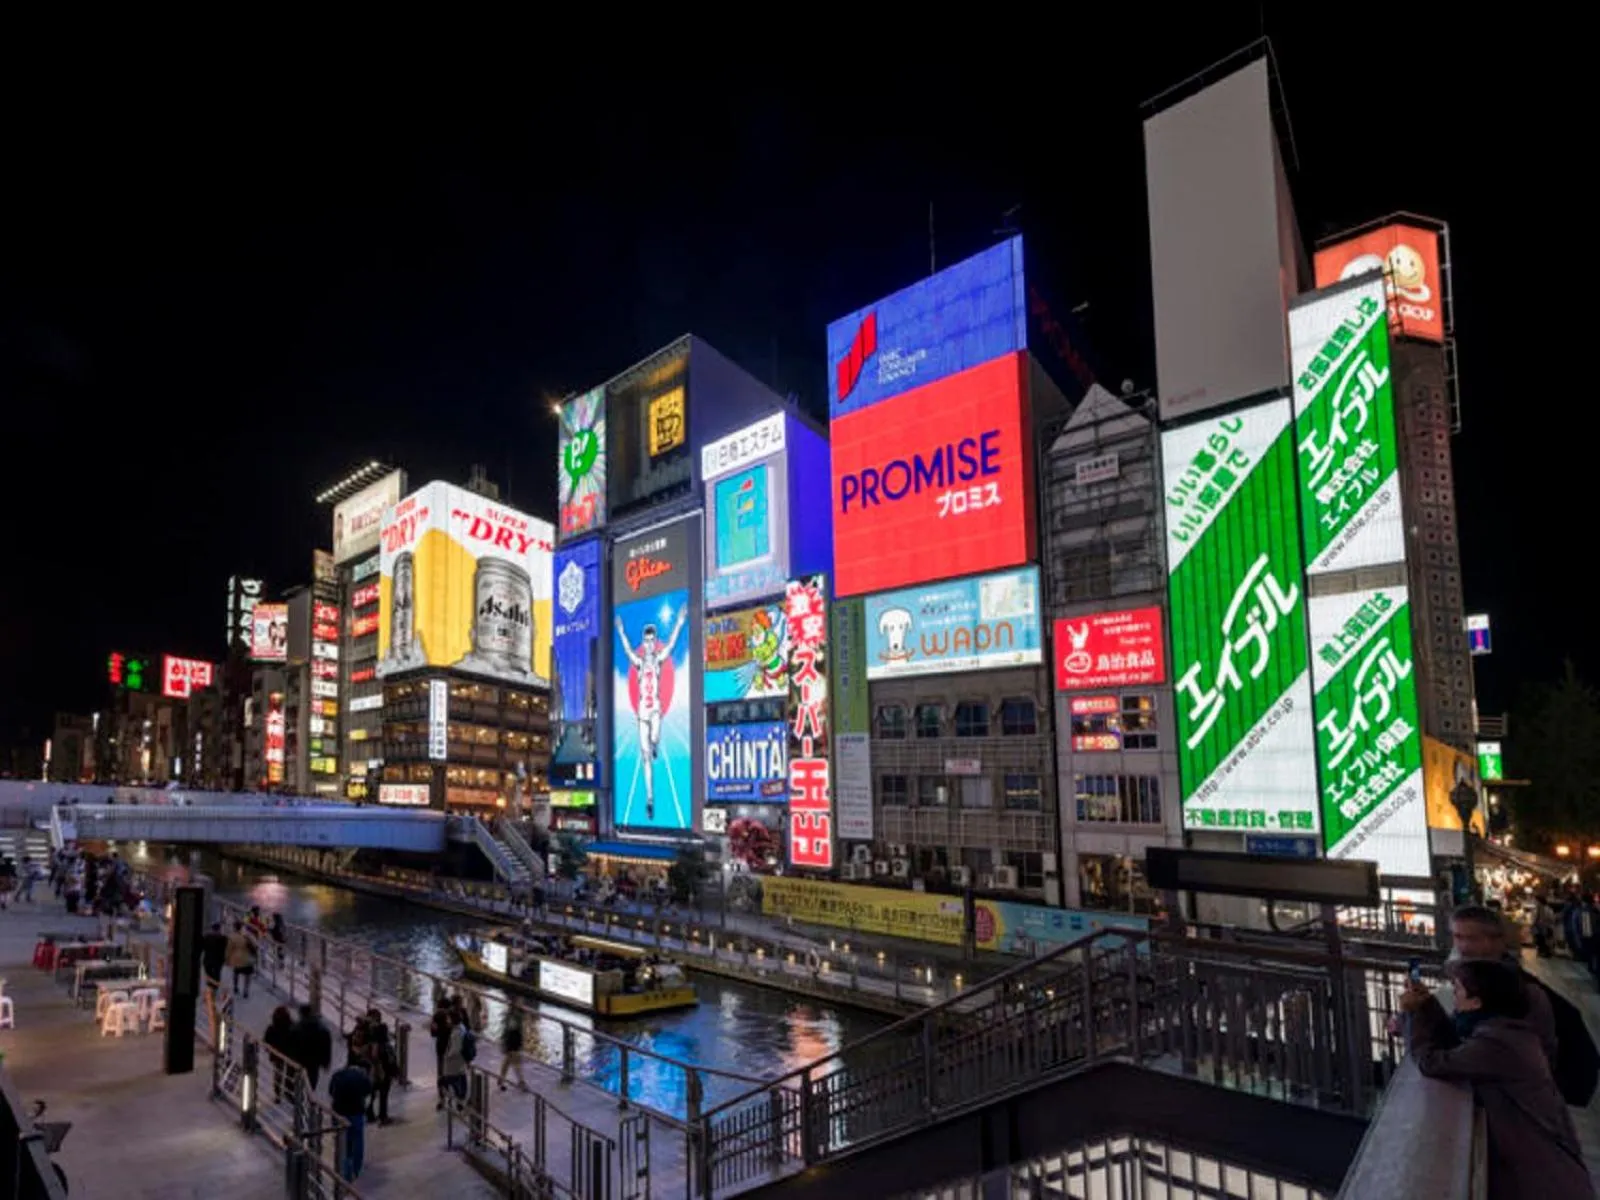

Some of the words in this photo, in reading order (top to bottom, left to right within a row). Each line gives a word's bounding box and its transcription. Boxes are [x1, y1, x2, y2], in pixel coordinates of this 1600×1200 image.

[1298, 360, 1390, 471] エイブル
[841, 429, 1002, 514] PROMISE
[936, 481, 1002, 518] プロミス
[1315, 438, 1379, 504] 株式会社
[1320, 467, 1379, 530] エイブル
[485, 507, 528, 530] SUPER
[625, 558, 672, 592] Glico
[479, 596, 529, 627] Asahi
[920, 621, 1014, 656] WAON
[1175, 572, 1299, 721] エイブル
[1316, 649, 1413, 752] エイブル
[1340, 760, 1405, 820] 株式会社
